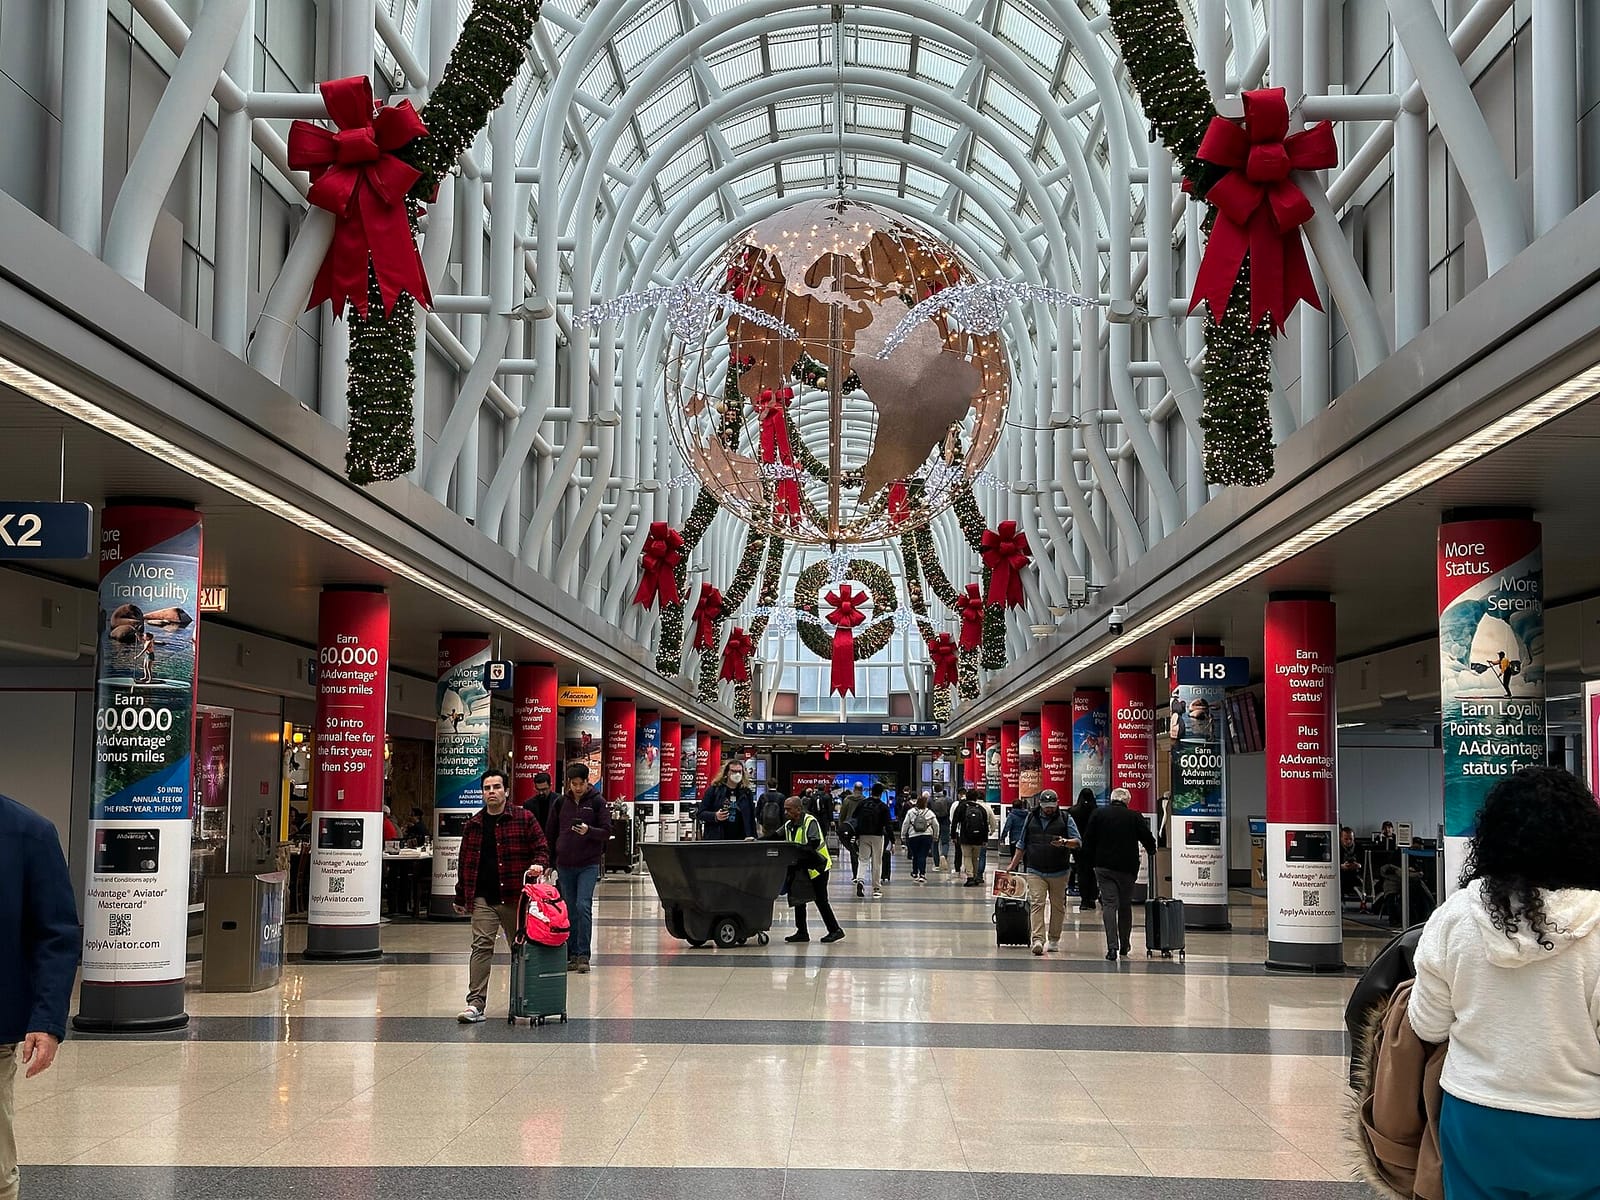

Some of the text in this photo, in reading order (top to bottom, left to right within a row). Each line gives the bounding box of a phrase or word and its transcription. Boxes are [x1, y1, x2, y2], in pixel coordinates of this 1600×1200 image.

[102, 529, 120, 542] ore
[1445, 542, 1485, 558] More
[128, 563, 175, 580] More
[1445, 561, 1493, 577] Status.
[1499, 576, 1537, 592] More
[337, 634, 358, 644] Earn
[320, 647, 378, 667] 60,000
[1296, 649, 1318, 659] Earn
[453, 668, 478, 678] More
[1200, 662, 1226, 679] H3
[1275, 663, 1334, 676] Loyalty Points
[448, 678, 483, 690] Serenity
[1289, 678, 1324, 688] toward
[321, 684, 373, 695] bonus miles
[115, 693, 144, 706] Earn
[1117, 708, 1154, 722] 60,000
[1461, 701, 1543, 720] Earn Loyalty
[96, 708, 172, 734] 60,000
[326, 717, 364, 728] $0 intro
[521, 714, 543, 722] toward
[1298, 726, 1318, 736] Plus
[1450, 722, 1491, 736] Points
[1495, 721, 1524, 736] and
[317, 731, 375, 742] annual fee for
[451, 734, 480, 746] Loyalty
[318, 745, 372, 759] the first year,
[449, 746, 464, 754] and
[1297, 742, 1319, 750] earn
[97, 749, 165, 762] bonus miles
[1180, 754, 1223, 769] 60,000
[322, 761, 341, 772] then
[1462, 761, 1507, 775] status
[1280, 769, 1333, 779] bonus miles
[1183, 778, 1204, 786] bonus
[104, 805, 114, 813] THE
[114, 805, 132, 813] FIRST
[154, 805, 171, 813] THEN
